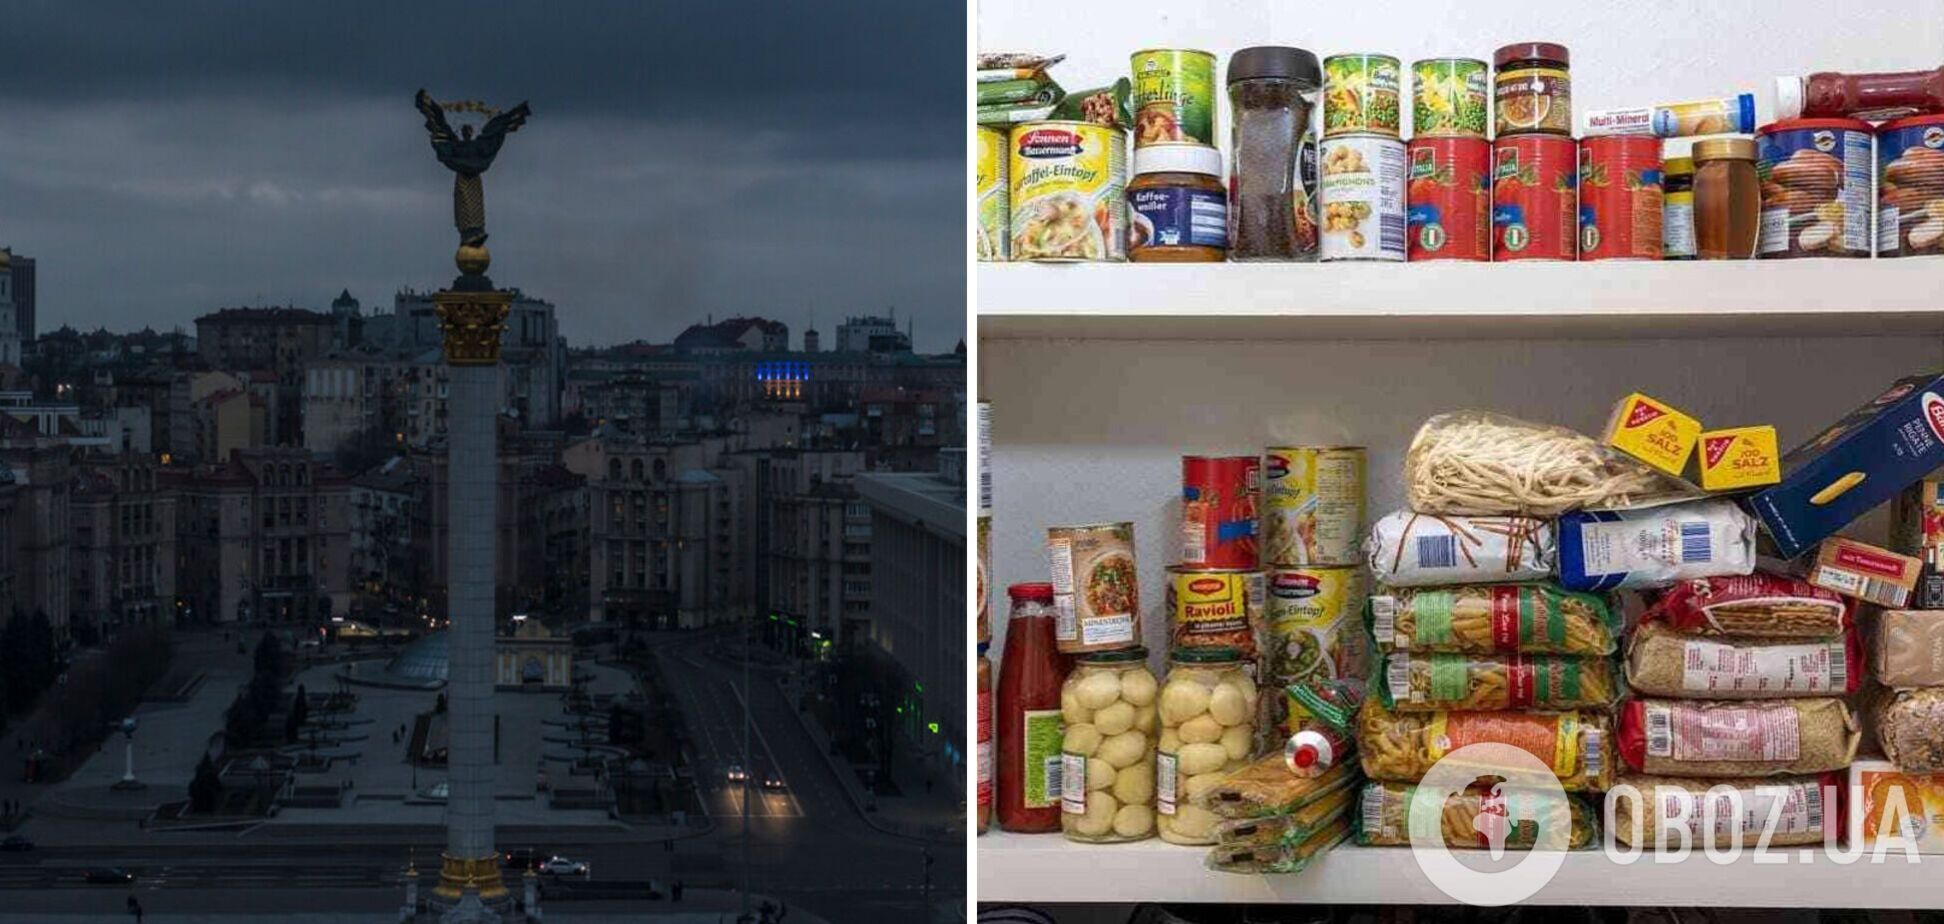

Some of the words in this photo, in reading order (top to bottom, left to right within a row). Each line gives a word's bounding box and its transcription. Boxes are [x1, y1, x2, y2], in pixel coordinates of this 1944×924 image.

[1589, 113, 1650, 127] Multi-Mineral
[1647, 434, 1684, 457] SALZ
[1904, 422, 1928, 455] RIGATE
[1732, 457, 1769, 470] SALZ
[1185, 602, 1236, 617] Ravioli
